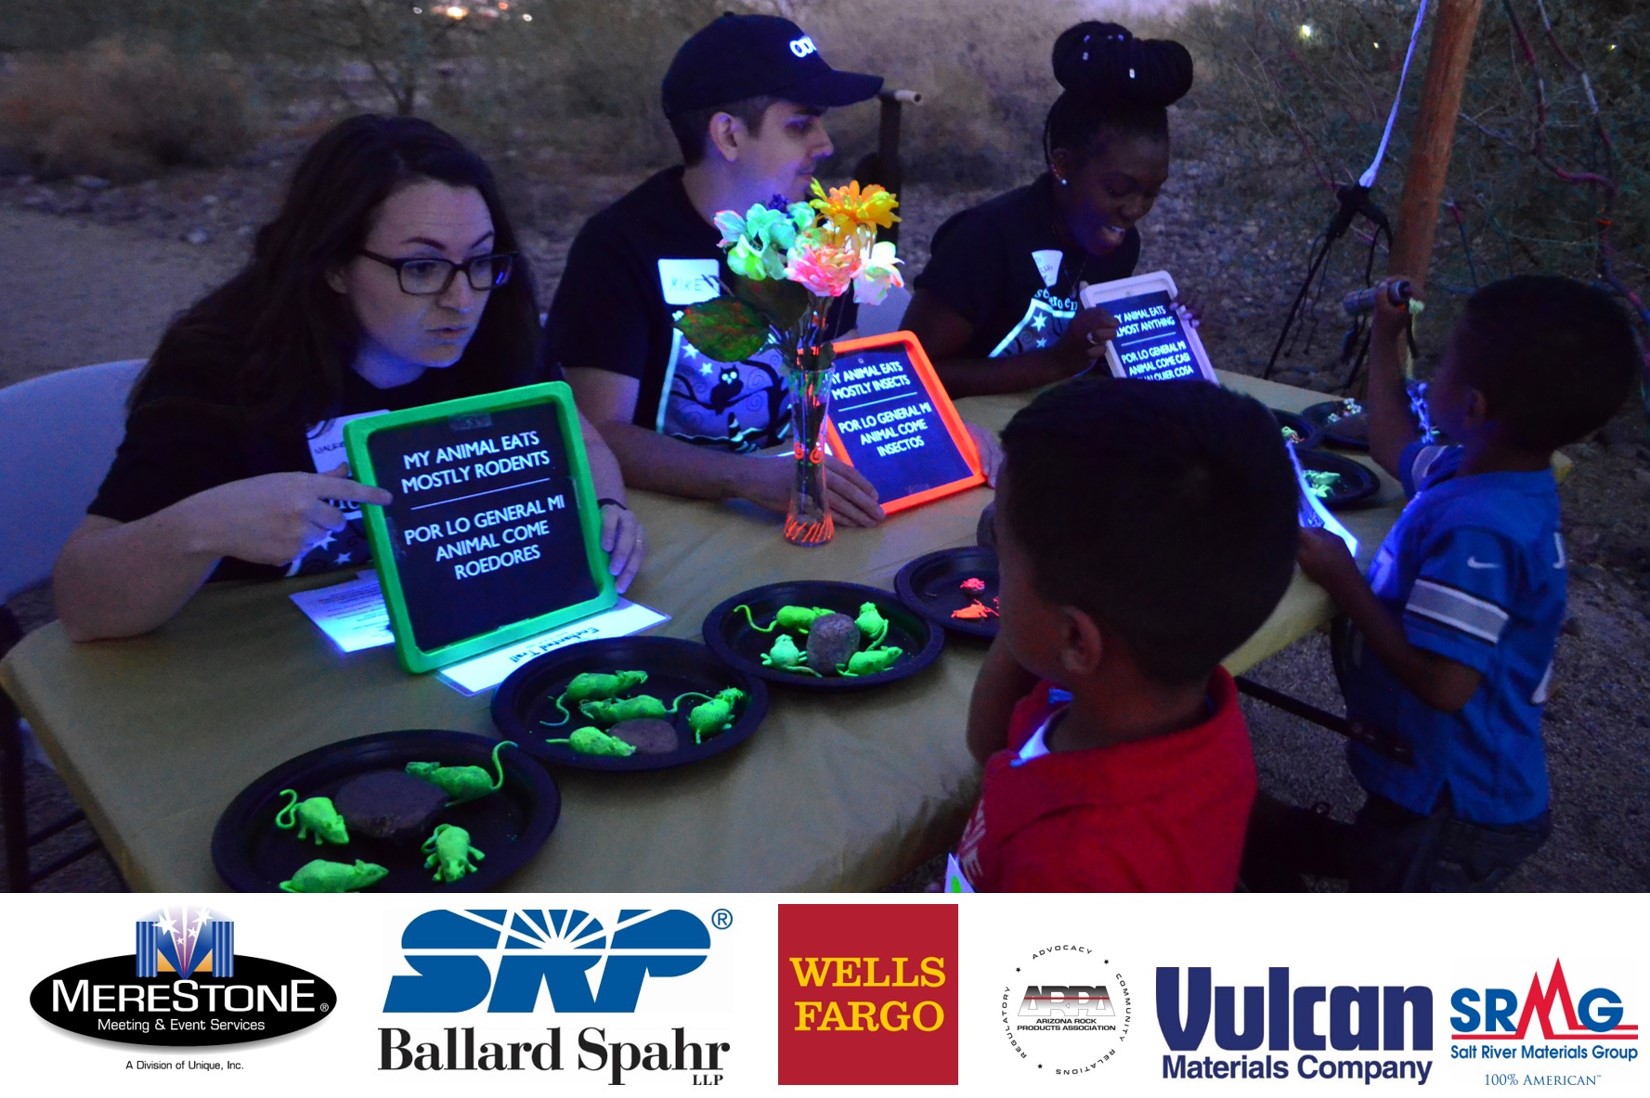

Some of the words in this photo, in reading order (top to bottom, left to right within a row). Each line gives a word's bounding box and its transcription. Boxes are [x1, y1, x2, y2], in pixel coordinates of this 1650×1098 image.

[1114, 313, 1123, 324] Y
[1124, 309, 1150, 321] ANIMAL
[1149, 305, 1167, 317] EATS
[1116, 323, 1139, 337] LMOST
[1141, 316, 1175, 331] ANYTHING
[1121, 351, 1139, 365] POR
[1137, 349, 1149, 361] LO
[1149, 342, 1179, 357] GENERAL
[1177, 340, 1187, 350] MI
[1129, 361, 1157, 376] ANIMAL
[1156, 355, 1176, 367] COME
[1175, 352, 1191, 364] CASI
[843, 365, 880, 383] ANIMAL
[880, 361, 904, 374] EATS
[1174, 365, 1194, 378] COSA
[832, 381, 871, 401] MOSTLY
[872, 374, 911, 392] INSECTS
[838, 418, 862, 434] POR
[862, 415, 877, 429] LO
[877, 406, 919, 425] GENERAL
[920, 402, 932, 414] MI
[860, 428, 898, 446] ANIMAL
[898, 418, 928, 434] COME
[403, 450, 430, 470] MY
[436, 437, 500, 464] ANIMAL
[501, 430, 540, 452] EATS
[876, 435, 925, 457] INSECTOS
[401, 466, 472, 494] MOSTLY
[475, 449, 551, 479] RODENTS
[405, 525, 442, 545] POR
[446, 516, 471, 536] LO
[474, 502, 545, 529] GENERAL
[548, 494, 565, 511] MI
[435, 534, 500, 562] ANIMAL
[502, 520, 550, 544] COME
[454, 544, 541, 580] ROEDORES
